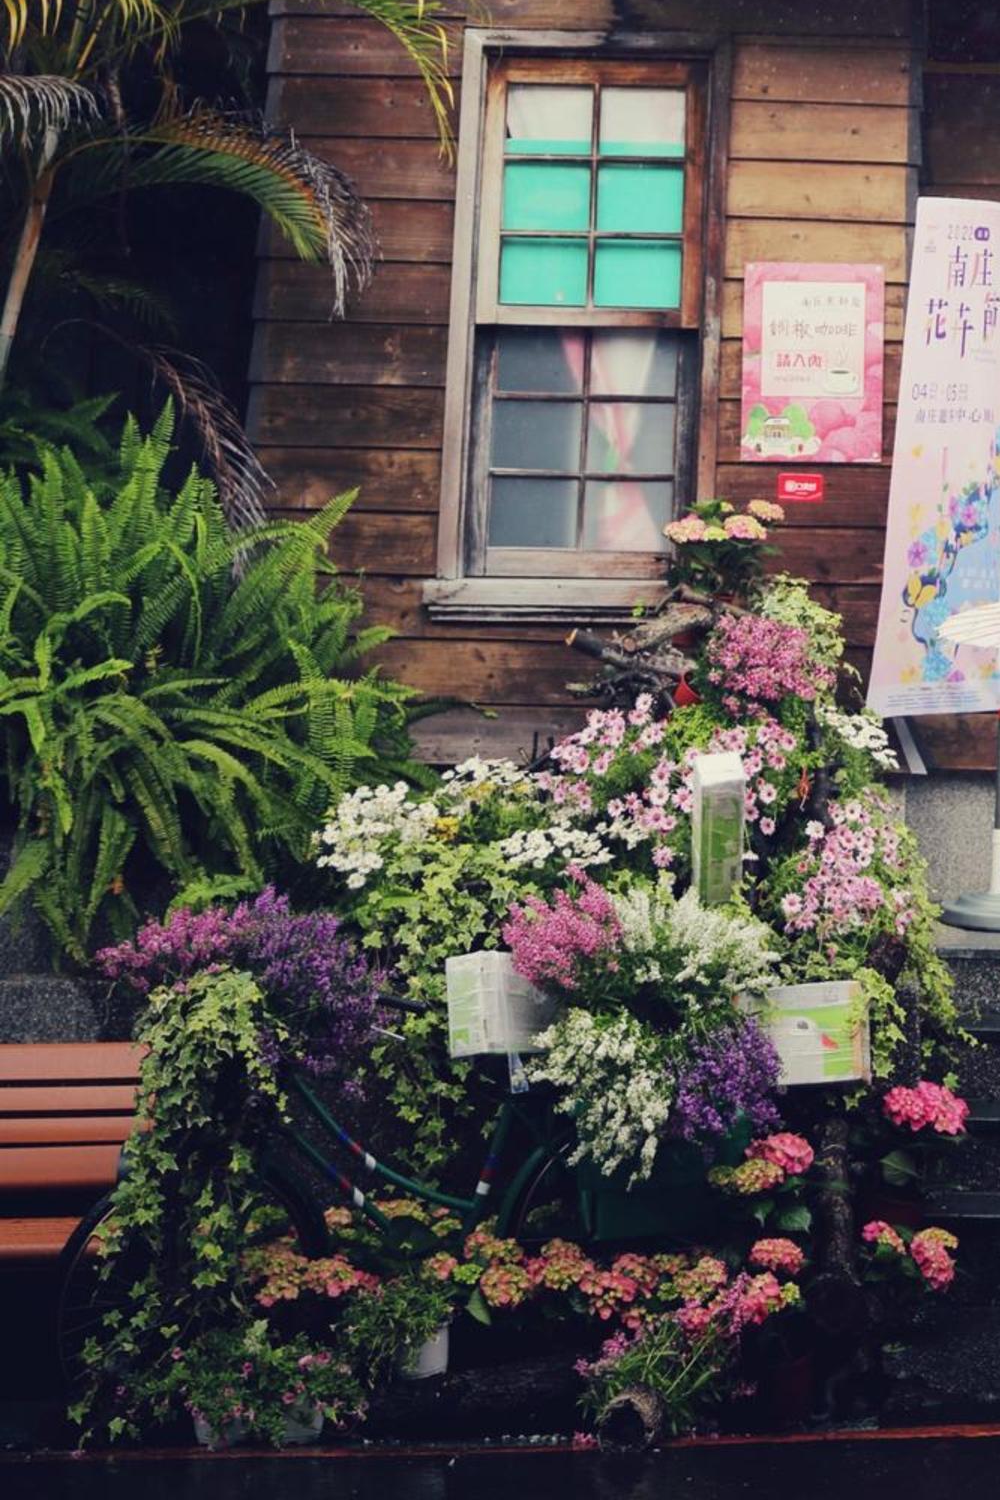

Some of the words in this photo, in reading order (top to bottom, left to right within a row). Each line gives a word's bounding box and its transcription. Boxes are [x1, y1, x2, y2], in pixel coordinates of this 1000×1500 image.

[946, 244, 994, 290] 南庄
[776, 352, 823, 369] 請入內
